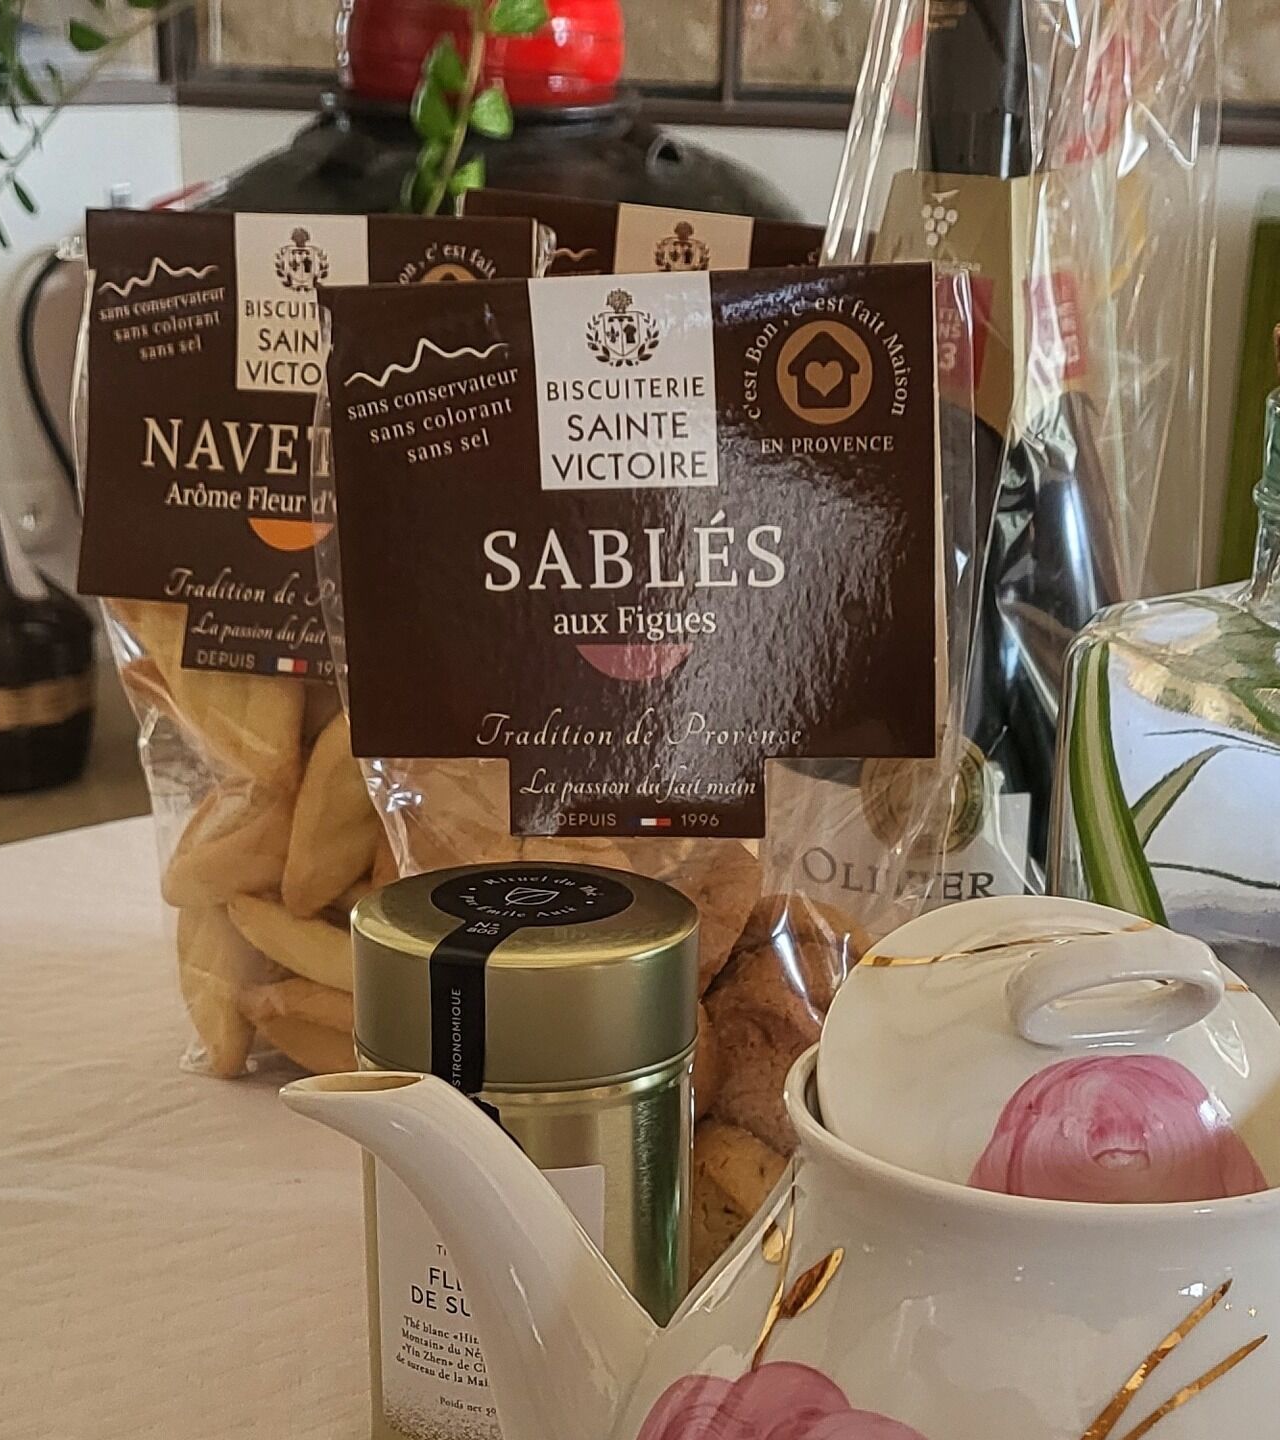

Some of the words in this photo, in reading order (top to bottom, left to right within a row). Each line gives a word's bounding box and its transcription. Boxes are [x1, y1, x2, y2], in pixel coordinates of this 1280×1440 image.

[98, 306, 130, 321] sans
[133, 287, 225, 316] conservateur
[113, 326, 149, 342] sans
[154, 310, 220, 334] colorant
[139, 344, 174, 360] sans
[179, 335, 201, 353] sel
[851, 300, 885, 335] fait
[882, 333, 911, 416] Maison
[347, 399, 389, 421] sans
[394, 367, 518, 410] conservateur
[546, 376, 706, 402] BISCUITERIE
[370, 420, 416, 444] sans
[423, 397, 513, 431] colorant
[567, 411, 689, 442] SAINTE
[407, 439, 453, 464] sans
[461, 428, 490, 452] sel
[761, 438, 784, 454] EN
[791, 435, 894, 453] PROVENCE
[552, 451, 708, 481] VICTOIRE
[166, 481, 241, 509] Arôme
[248, 486, 308, 514] Fleur
[483, 509, 785, 592] SABLÉS
[164, 566, 265, 603] Tradition
[273, 571, 300, 605] de
[191, 611, 218, 636] La
[221, 623, 273, 644] passion
[277, 614, 298, 642] du
[289, 616, 327, 650] fait
[553, 611, 609, 635] aux
[617, 606, 717, 642] Figues
[197, 650, 255, 669] DEPUIS
[476, 708, 613, 746] Tradition
[625, 707, 655, 746] de
[668, 711, 803, 746] Provence
[519, 768, 555, 795] La
[561, 778, 630, 802] passion
[636, 764, 661, 795] du
[655, 765, 700, 804] fait
[706, 778, 757, 795] main
[557, 812, 616, 827] DEPUIS
[680, 812, 719, 827] 1996
[411, 1285, 437, 1310] DE
[403, 1314, 420, 1330] Thé
[423, 1322, 450, 1339] blanc
[448, 1343, 461, 1355] du
[457, 1359, 470, 1371] de
[396, 1351, 405, 1365] de
[407, 1360, 435, 1377] sureau
[438, 1368, 450, 1381] de
[454, 1371, 463, 1383] la
[440, 1395, 463, 1409] Poids
[467, 1404, 482, 1412] net
